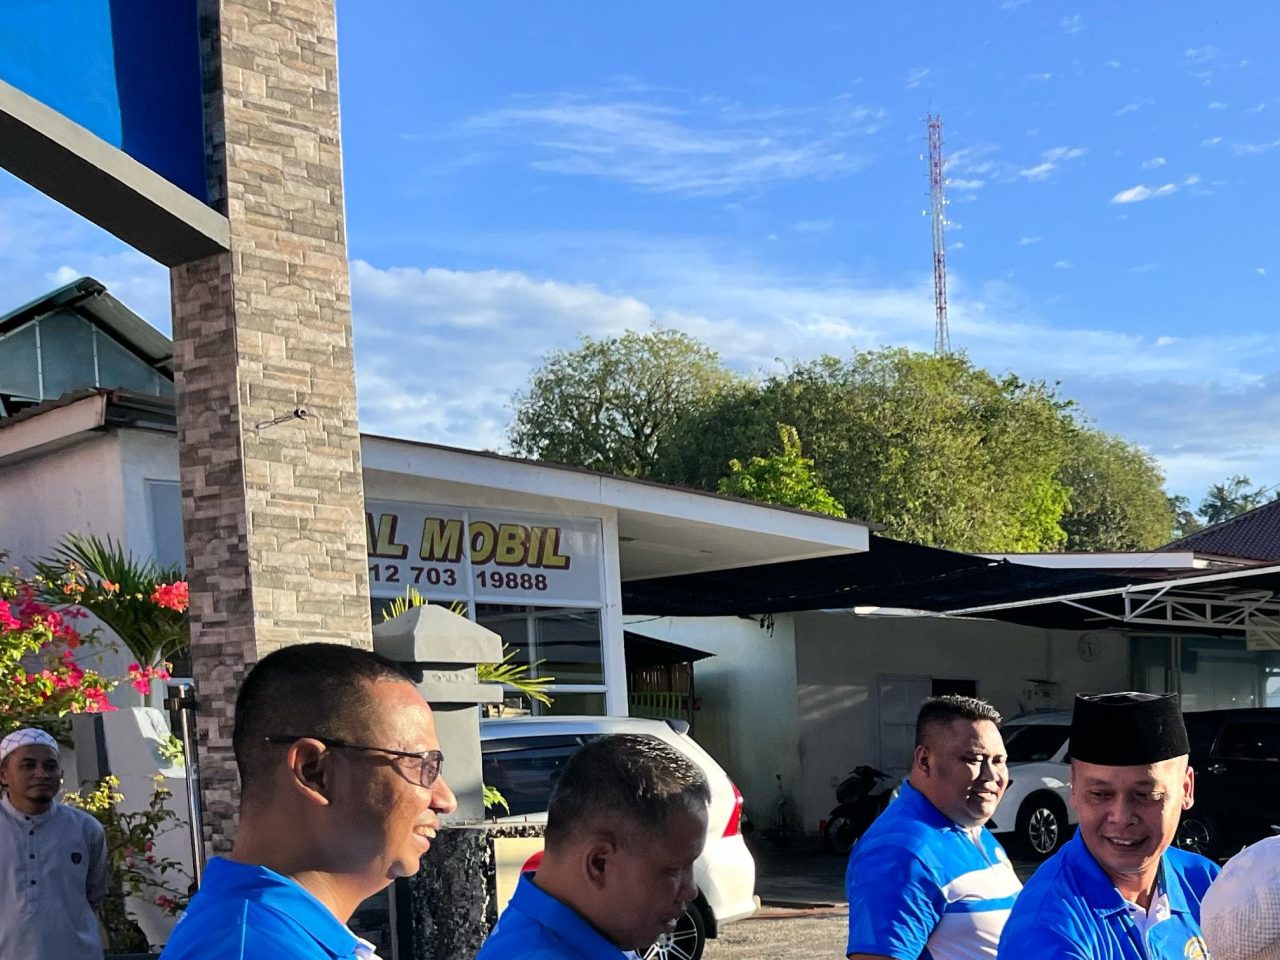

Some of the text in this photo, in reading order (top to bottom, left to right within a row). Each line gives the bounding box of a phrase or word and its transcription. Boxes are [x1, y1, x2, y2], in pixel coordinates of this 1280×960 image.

[420, 516, 570, 570] MOBIL
[410, 566, 457, 587] 703
[476, 570, 548, 591] 19888
